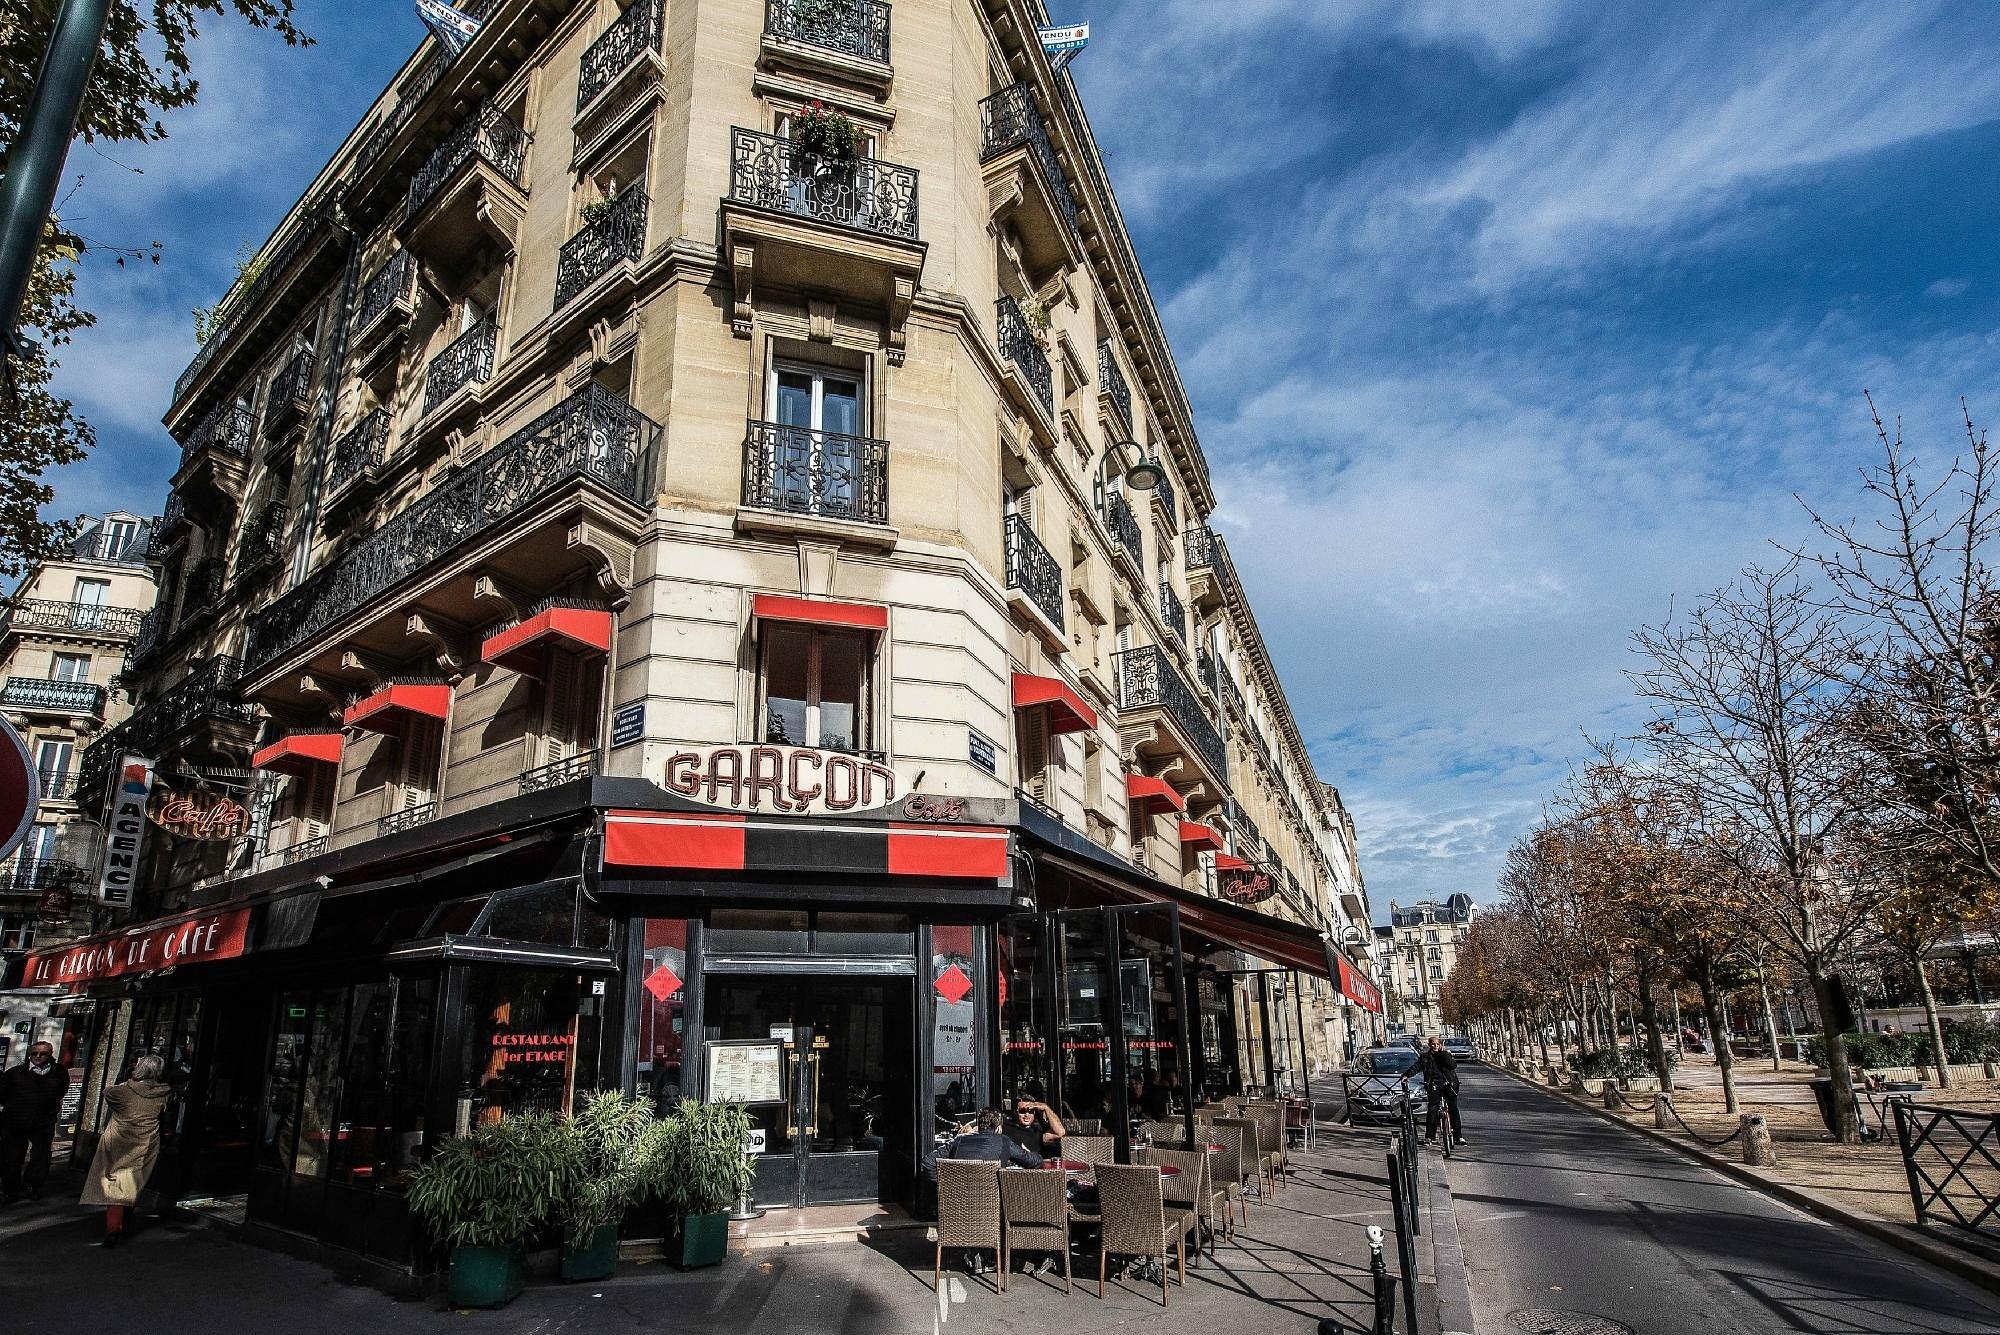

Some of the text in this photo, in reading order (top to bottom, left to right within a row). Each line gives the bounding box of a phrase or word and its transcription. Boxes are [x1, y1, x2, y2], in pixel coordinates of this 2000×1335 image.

[665, 748, 895, 812] GARÇON
[162, 800, 243, 832] Café
[104, 802, 142, 903] AGENCE
[1226, 874, 1269, 898] Café
[35, 917, 220, 980] LE GARÇON DE CAFÉ
[492, 1034, 575, 1045] RESTAURANT
[525, 1050, 566, 1062] ETAGE
